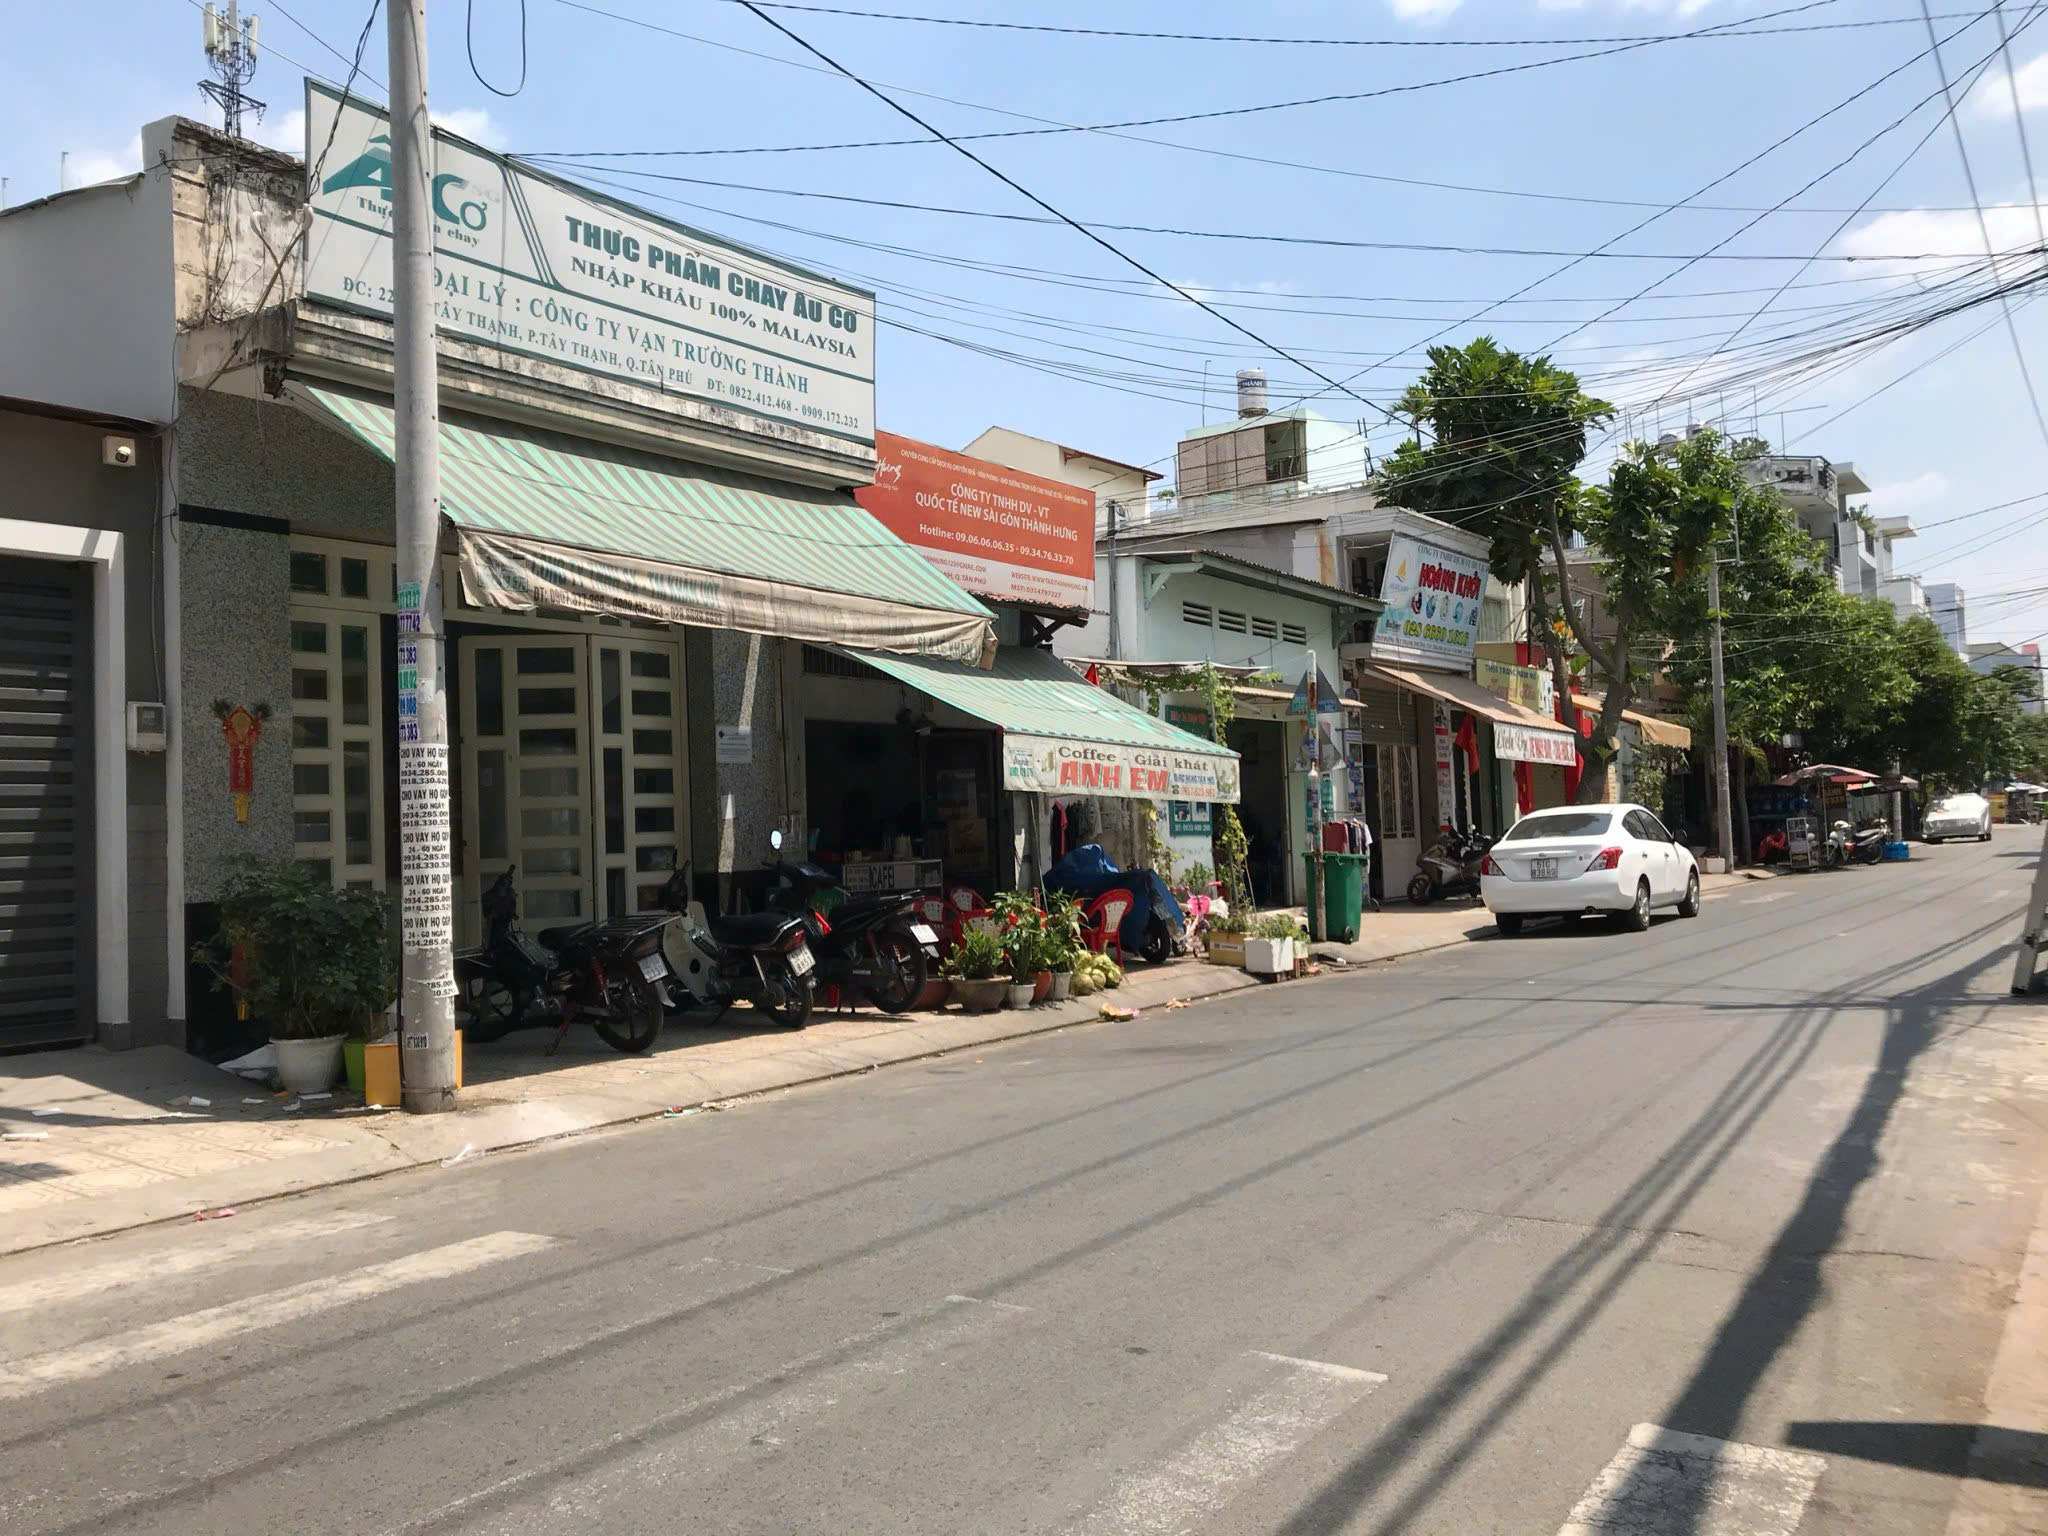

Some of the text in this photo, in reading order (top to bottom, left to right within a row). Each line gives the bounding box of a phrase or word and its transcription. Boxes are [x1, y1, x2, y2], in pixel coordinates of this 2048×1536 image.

[447, 228, 480, 248] chay
[564, 215, 858, 334] THỰC PHẨM CHAY ÂU CƠ
[571, 256, 635, 289] NHẬP
[709, 301, 757, 329] 100%
[762, 318, 857, 359] MALAYSIA
[478, 280, 507, 307] LÝ
[515, 297, 521, 312] :
[529, 297, 588, 332] CÔNG
[596, 316, 622, 341] TY
[627, 326, 666, 354] VẠN
[672, 338, 746, 376] TRƯỜNG
[752, 361, 809, 394] THÀNH
[343, 276, 372, 298] ĐC:
[378, 287, 394, 303] 22
[466, 310, 523, 342] THẠNH,
[527, 327, 567, 352] P.TÂY
[571, 341, 622, 367] THẠNH,
[626, 356, 664, 377] Q.TÂN
[669, 367, 693, 386] PHÚ
[707, 377, 726, 394] ĐT:
[729, 383, 792, 413] 0822.412.468
[801, 403, 859, 429] 0909.172.232
[951, 482, 978, 501] CÔNG
[979, 490, 991, 504] TY
[992, 494, 1018, 512] TNHH
[1020, 501, 1032, 514] DV
[1037, 505, 1050, 519] VT
[915, 491, 1078, 541] QUỐC TẾ NEW SÀI GÒN THÀNH HƯNG
[919, 523, 954, 540] Hotline:
[955, 531, 1014, 553] 09.06.06.06.35
[1020, 545, 1074, 565] 09.34.76.33.70
[1010, 584, 1026, 592] MST:
[401, 748, 411, 759] CHO
[412, 747, 425, 758] VAY
[427, 748, 437, 759] HỌ
[1058, 746, 1116, 762] Coffee
[1134, 753, 1168, 768] Giải
[1174, 757, 1208, 771] khát
[1060, 761, 1121, 790] ANH
[1130, 766, 1169, 793] EM
[401, 789, 412, 800] CHO
[413, 789, 427, 799] VAY
[429, 789, 438, 801] HỌ
[403, 832, 413, 843] CHO
[415, 832, 429, 842] VAY
[431, 831, 440, 843] HỌ
[404, 875, 414, 885] CHO
[416, 874, 429, 885] VAY
[432, 874, 441, 885] HỌ
[404, 918, 414, 928] CHO
[415, 917, 429, 928] VAY
[431, 916, 440, 928] HỌ
